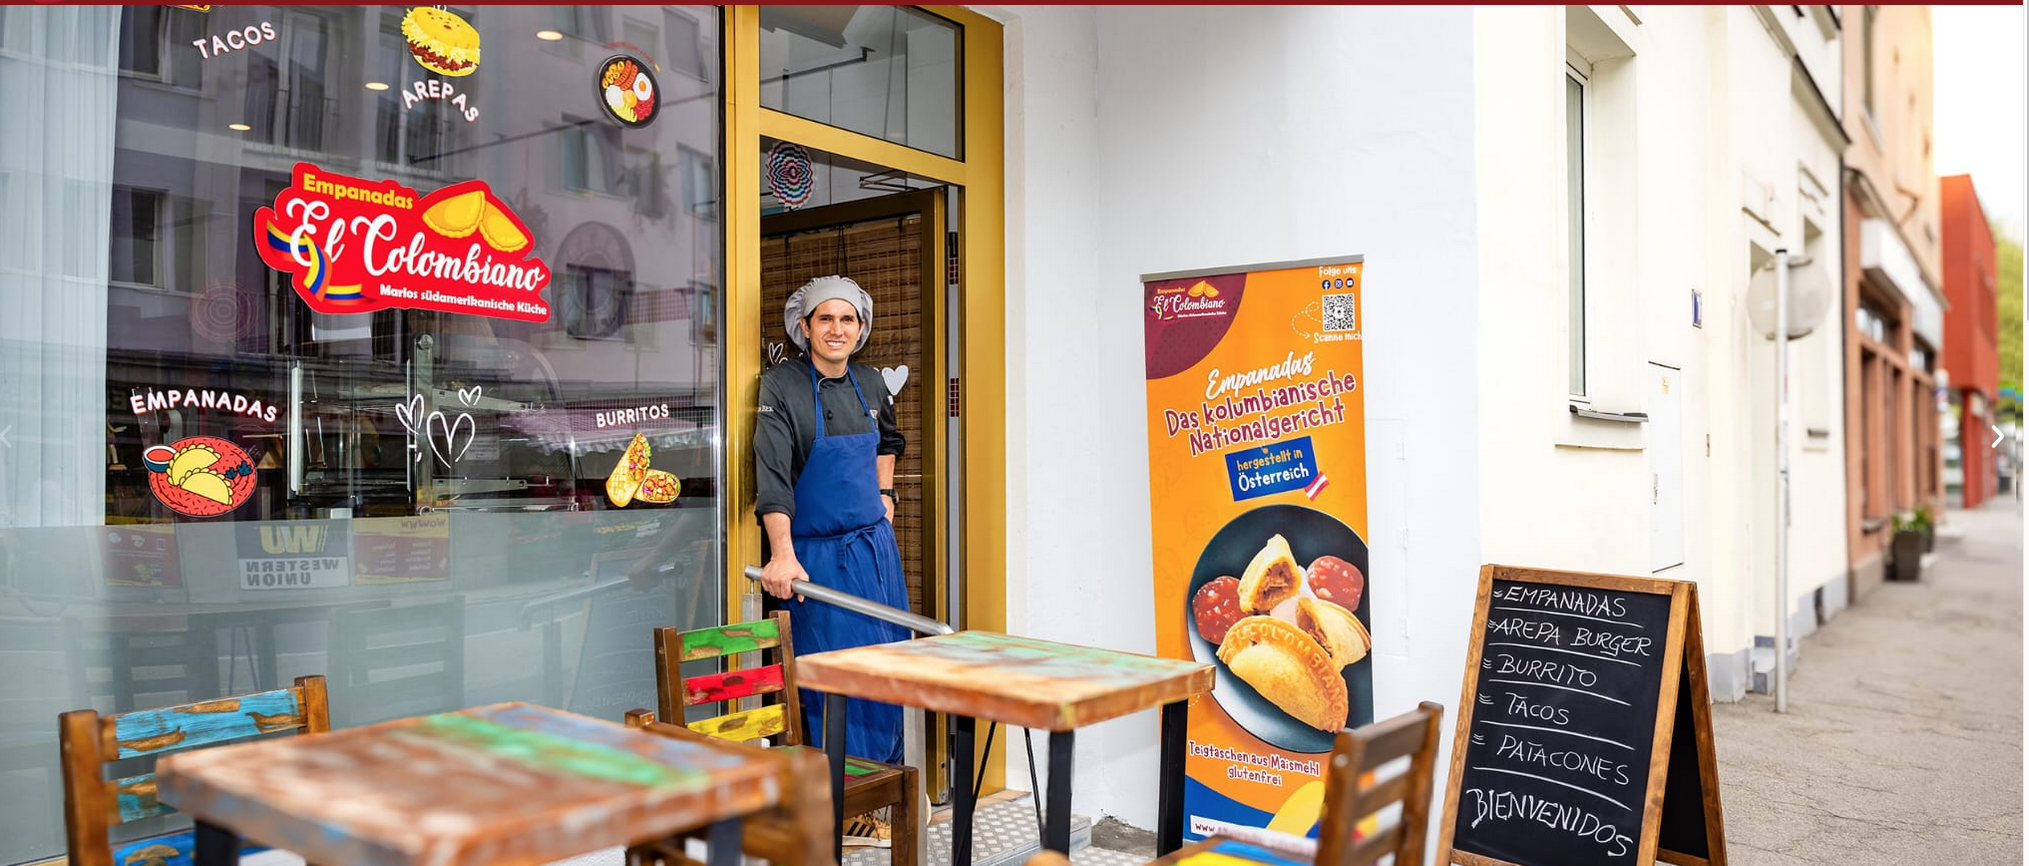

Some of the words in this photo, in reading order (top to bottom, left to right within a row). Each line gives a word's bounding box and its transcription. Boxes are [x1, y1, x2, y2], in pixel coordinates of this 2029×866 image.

[193, 21, 276, 59] TACOS
[402, 79, 480, 122] AREPAS
[303, 172, 413, 210] Empanadas
[286, 197, 346, 267] El
[350, 213, 546, 292] Colombiano
[1318, 266, 1341, 278] Folge
[1343, 266, 1358, 275] uns
[379, 283, 418, 300] Marios
[421, 289, 515, 312] südamerikanische
[516, 302, 548, 316] Küche
[1153, 295, 1169, 315] El
[1169, 294, 1226, 313] Colombiano
[1313, 332, 1343, 344] Scanne
[1344, 330, 1363, 341] mich
[1205, 350, 1316, 400] Empanadas
[130, 388, 278, 423] EMPANADAS
[596, 403, 669, 428] BURRITOS
[1165, 408, 1200, 438] Das
[1203, 370, 1356, 425] kolumbianische
[1189, 398, 1345, 456] Nationalgericht
[1236, 450, 1291, 471] hergestellt
[1293, 449, 1304, 460] in
[1238, 462, 1309, 492] Österreich
[1503, 586, 1627, 618] EMPANADAS
[1493, 618, 1561, 646] AREPA
[1570, 627, 1652, 657] BURGER
[1497, 653, 1597, 687] BURRITO
[1505, 691, 1570, 725] TACOS
[1189, 741, 1249, 763] Teigtaschen
[1251, 753, 1268, 767] aus
[1271, 755, 1320, 776] Maismehl
[1228, 765, 1282, 786] glutenfrei
[1496, 734, 1629, 785] PATACONES
[1465, 788, 1634, 857] BIENVENIDOS
